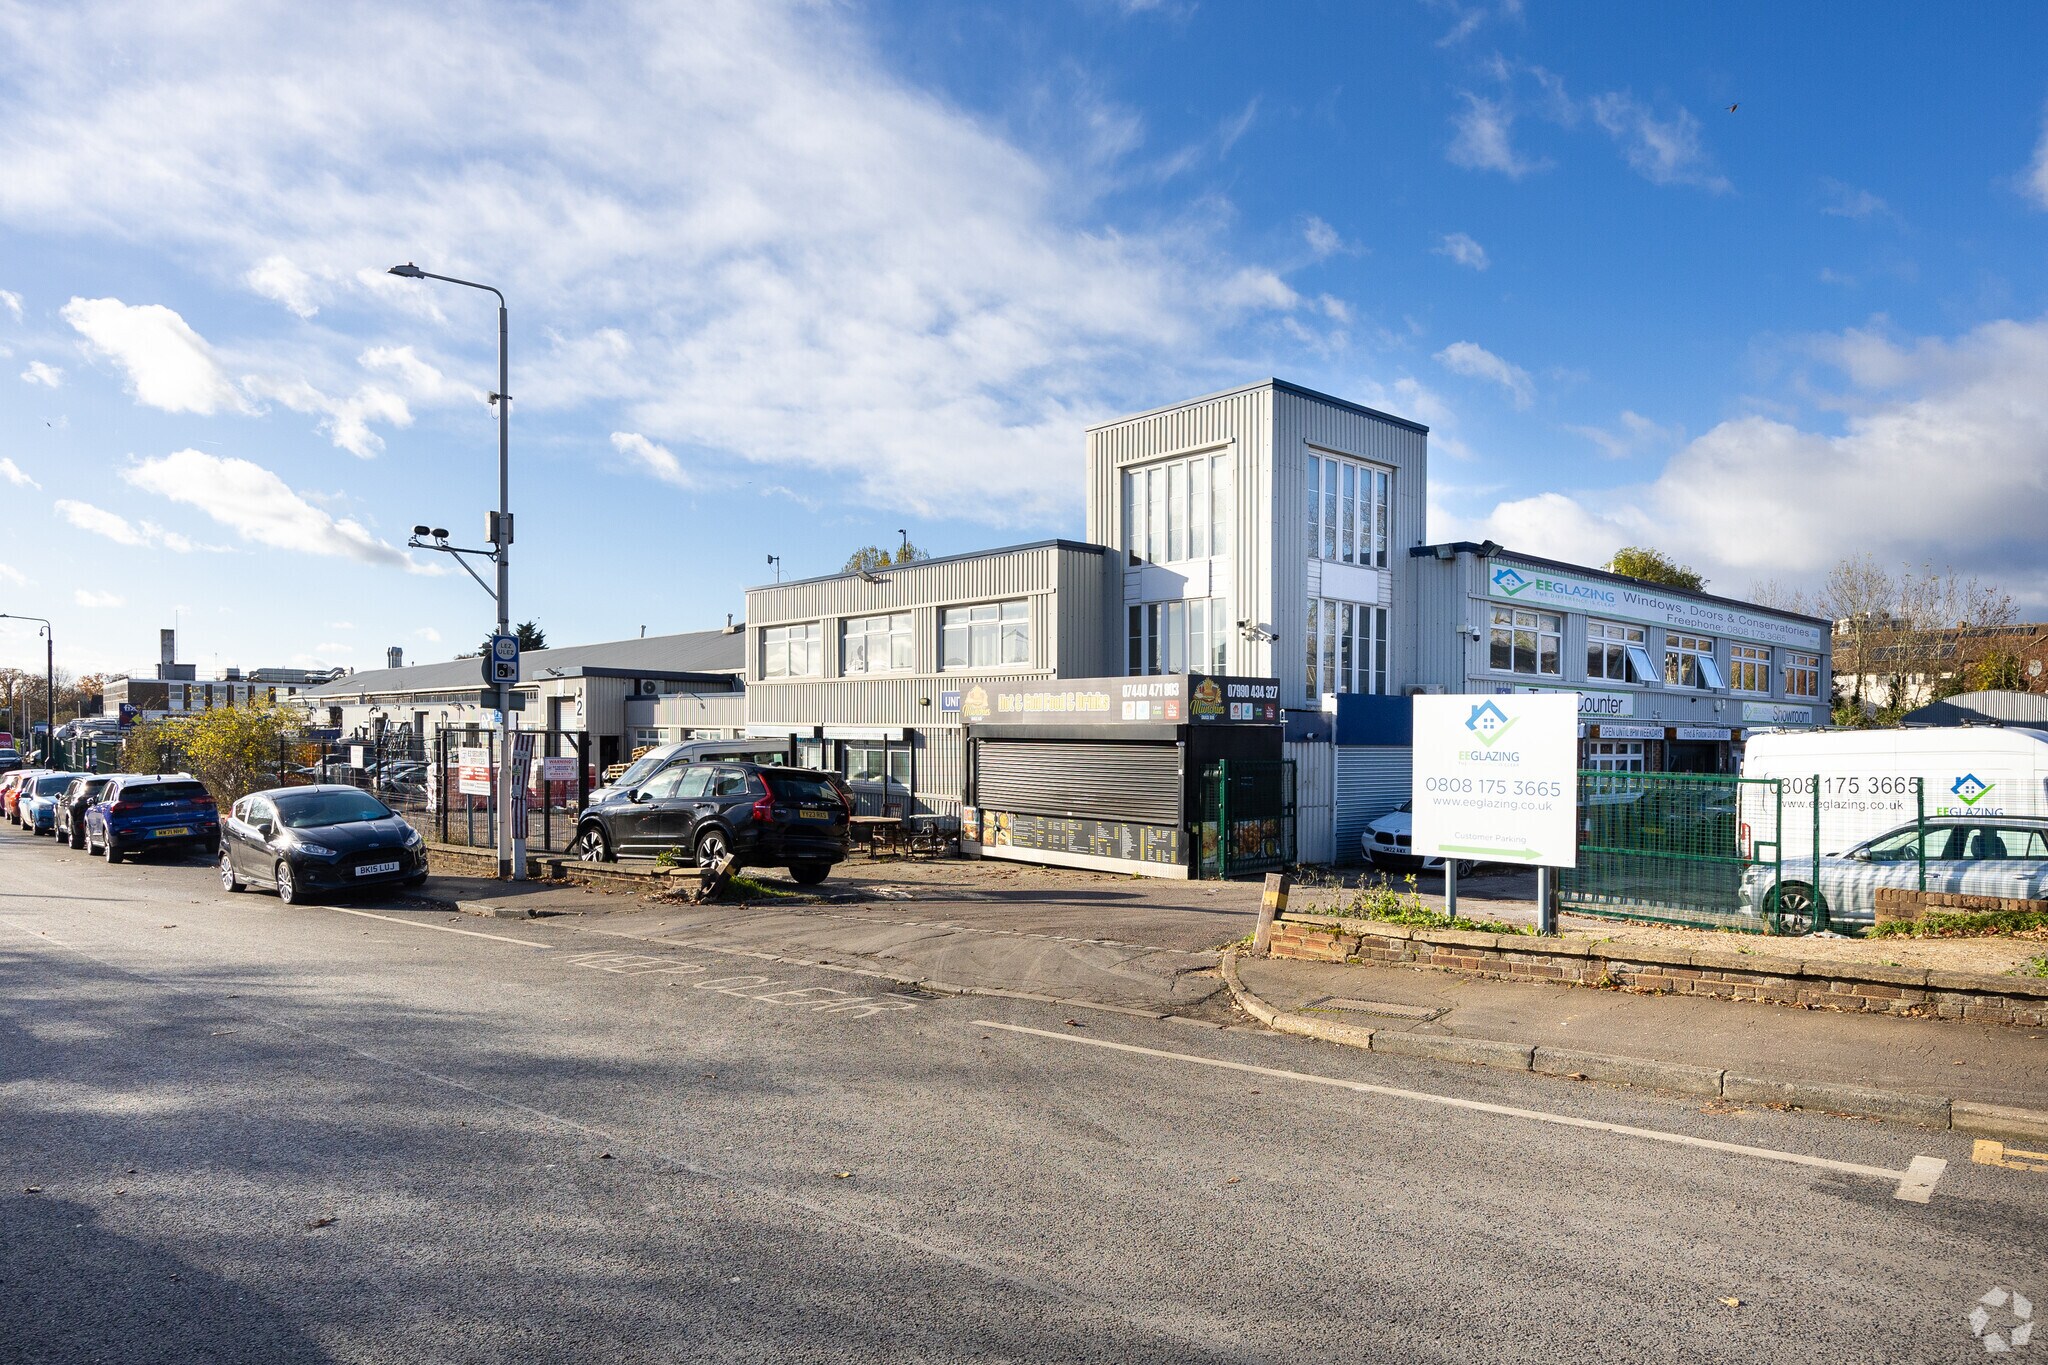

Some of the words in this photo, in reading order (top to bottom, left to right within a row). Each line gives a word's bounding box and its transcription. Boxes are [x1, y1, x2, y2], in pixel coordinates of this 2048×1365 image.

[1535, 579, 1615, 603] EEGLAZING
[1623, 591, 1686, 615] Windows,
[1690, 605, 1724, 621] Doors
[1727, 613, 1735, 624] &
[1738, 615, 1810, 638] Conservatories
[1666, 613, 1724, 632] Freephone:
[1727, 625, 1749, 636] 0808
[1752, 629, 1766, 639] 175
[1767, 632, 1787, 643] 3665
[1250, 685, 1265, 699] 434
[1265, 686, 1278, 699] 327
[576, 700, 583, 716] 2
[945, 696, 960, 707] UNI
[1043, 692, 1066, 712] Food
[1075, 691, 1111, 712] Drinks
[1190, 699, 1225, 716] Munchies
[1601, 726, 1616, 737] OPEN
[1616, 726, 1630, 737] UNTIL
[1458, 750, 1520, 762] EEGLAZING
[1425, 777, 1473, 793] 0808
[1478, 779, 1507, 795] 175
[1513, 780, 1561, 797] 3665
[1824, 777, 1860, 794] 175
[1867, 776, 1919, 794] 3665
[1432, 797, 1553, 812] www.eeglazing.co.uk
[1454, 832, 1493, 842] Customer
[1495, 835, 1527, 845] Parking
[360, 865, 378, 874] BK15
[380, 863, 395, 872] LUJ
[552, 950, 707, 976] KEEP
[692, 975, 917, 1019] CLEAR
